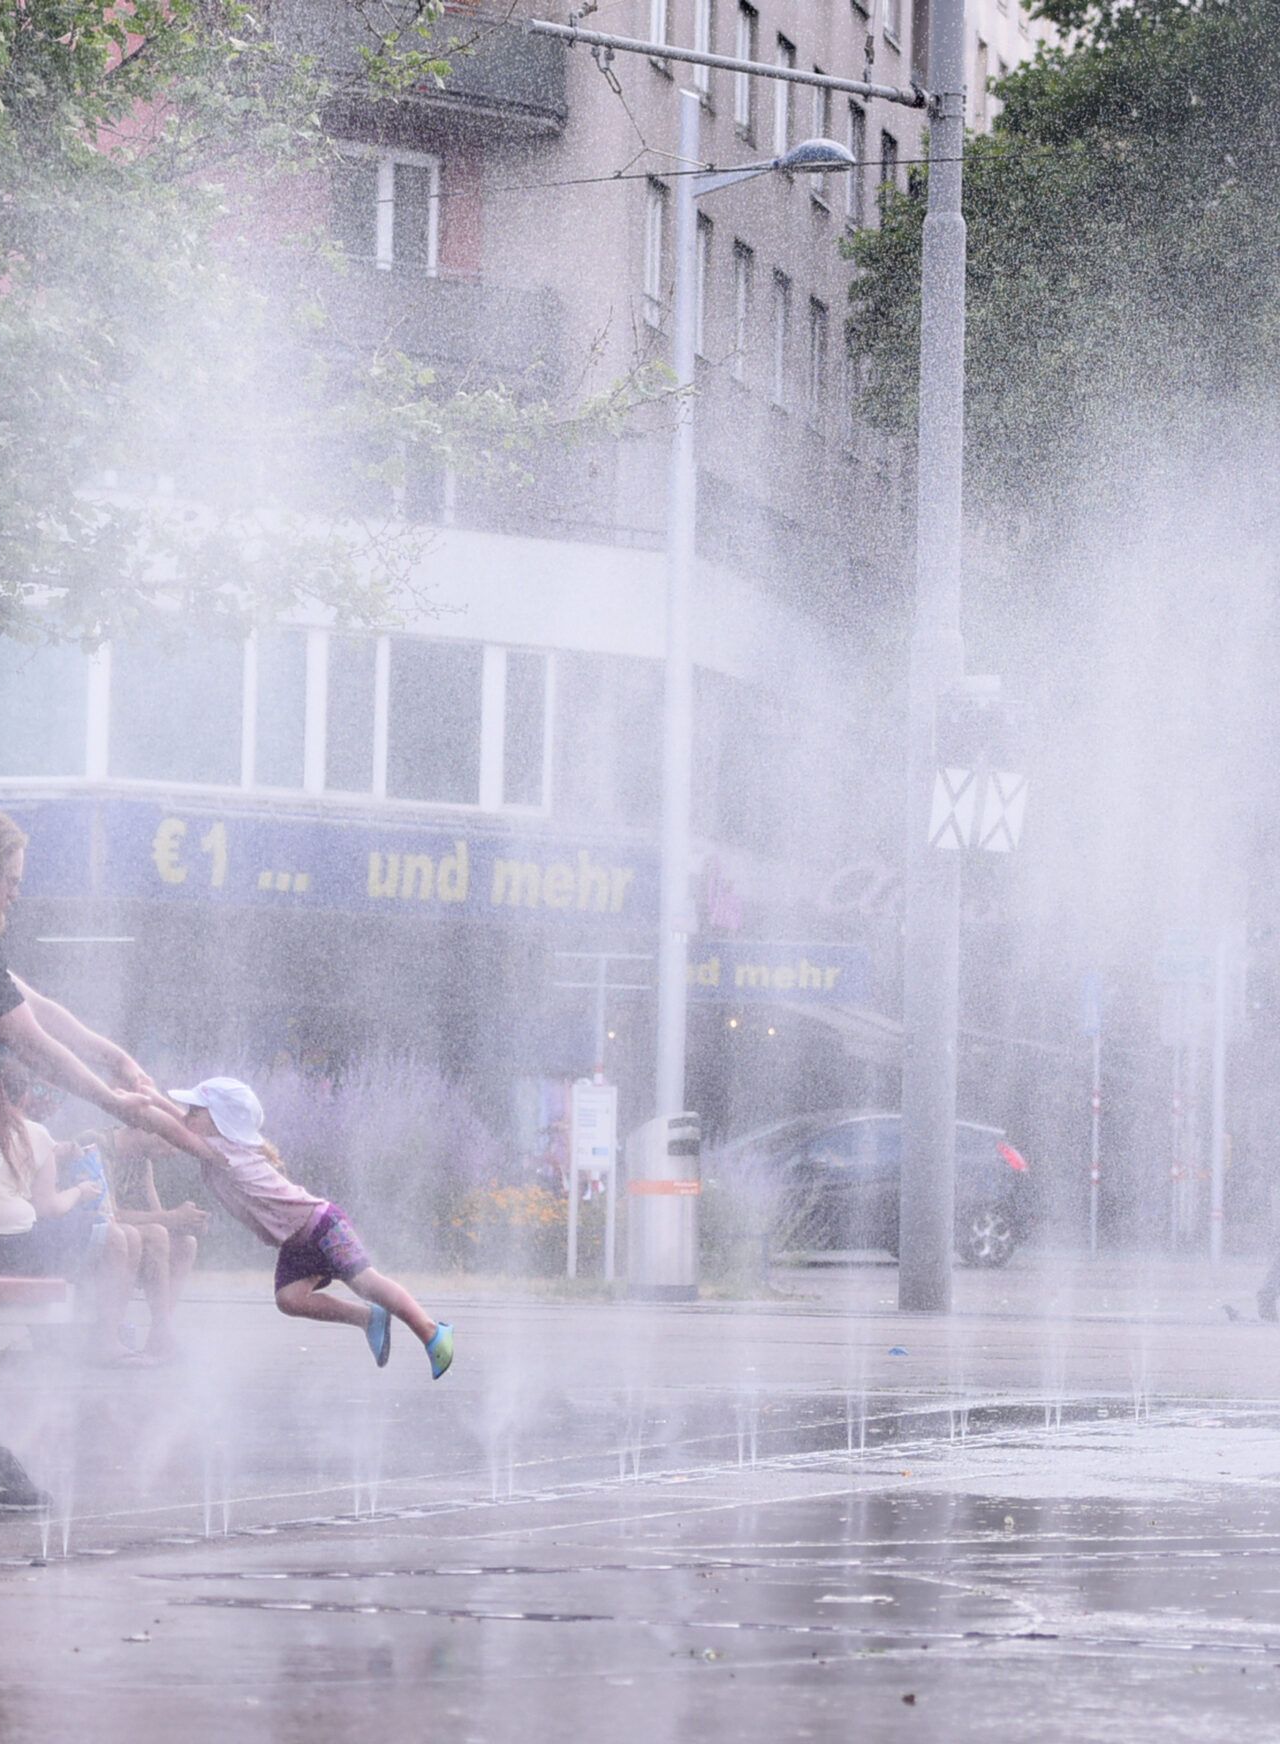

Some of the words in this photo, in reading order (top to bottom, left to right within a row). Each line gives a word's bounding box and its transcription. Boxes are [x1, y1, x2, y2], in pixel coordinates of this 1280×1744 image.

[366, 840, 469, 901] und
[490, 849, 636, 913] mehr
[733, 957, 842, 991] mehr
